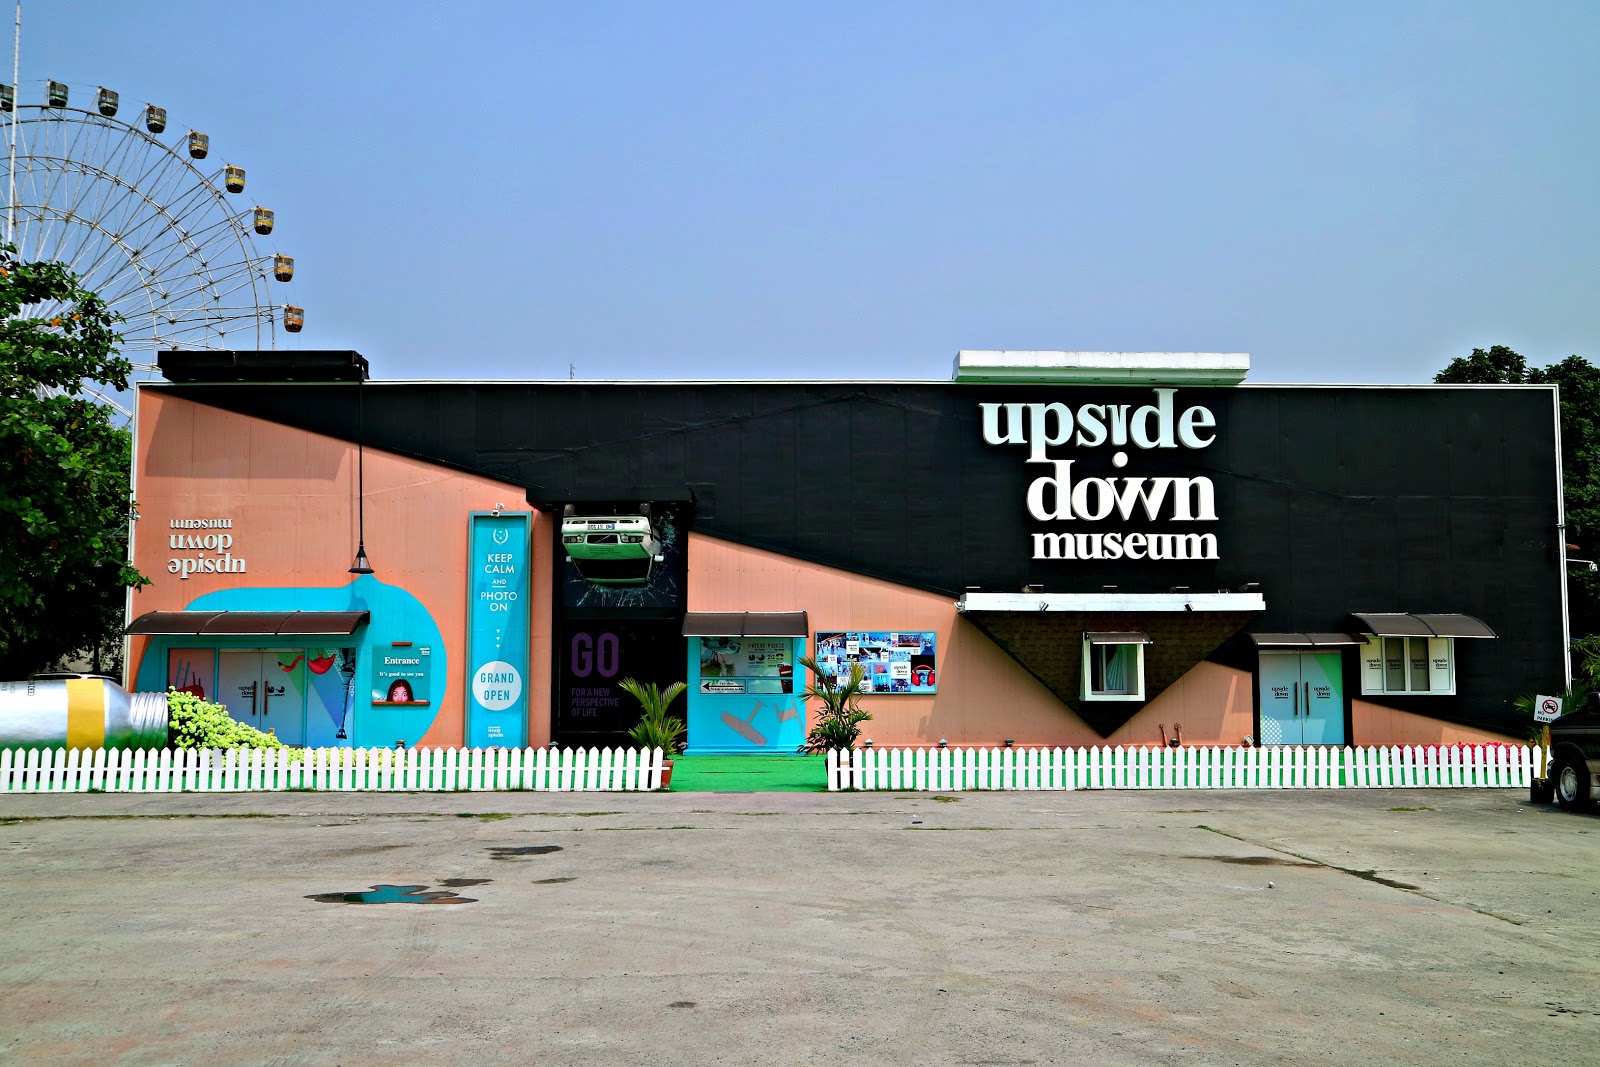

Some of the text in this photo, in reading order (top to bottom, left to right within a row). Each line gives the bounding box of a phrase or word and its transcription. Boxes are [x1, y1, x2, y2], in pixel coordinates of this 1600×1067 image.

[978, 388, 1217, 463] upside
[1026, 459, 1219, 521] down
[169, 518, 233, 529] museum
[169, 533, 233, 555] down
[1031, 532, 1220, 560] museum
[487, 553, 513, 563] KEEP
[167, 552, 247, 580] upside
[484, 564, 515, 574] CALM
[480, 591, 518, 601] PHOTO
[489, 602, 508, 612] ON
[384, 656, 420, 665] Entrance
[571, 632, 619, 678] GO
[480, 672, 514, 683] GRAND
[483, 690, 510, 701] OPEN
[571, 687, 610, 697] FOR A NEW
[571, 697, 620, 707] PERSPECTIVE
[571, 708, 597, 717] OF LIFE
